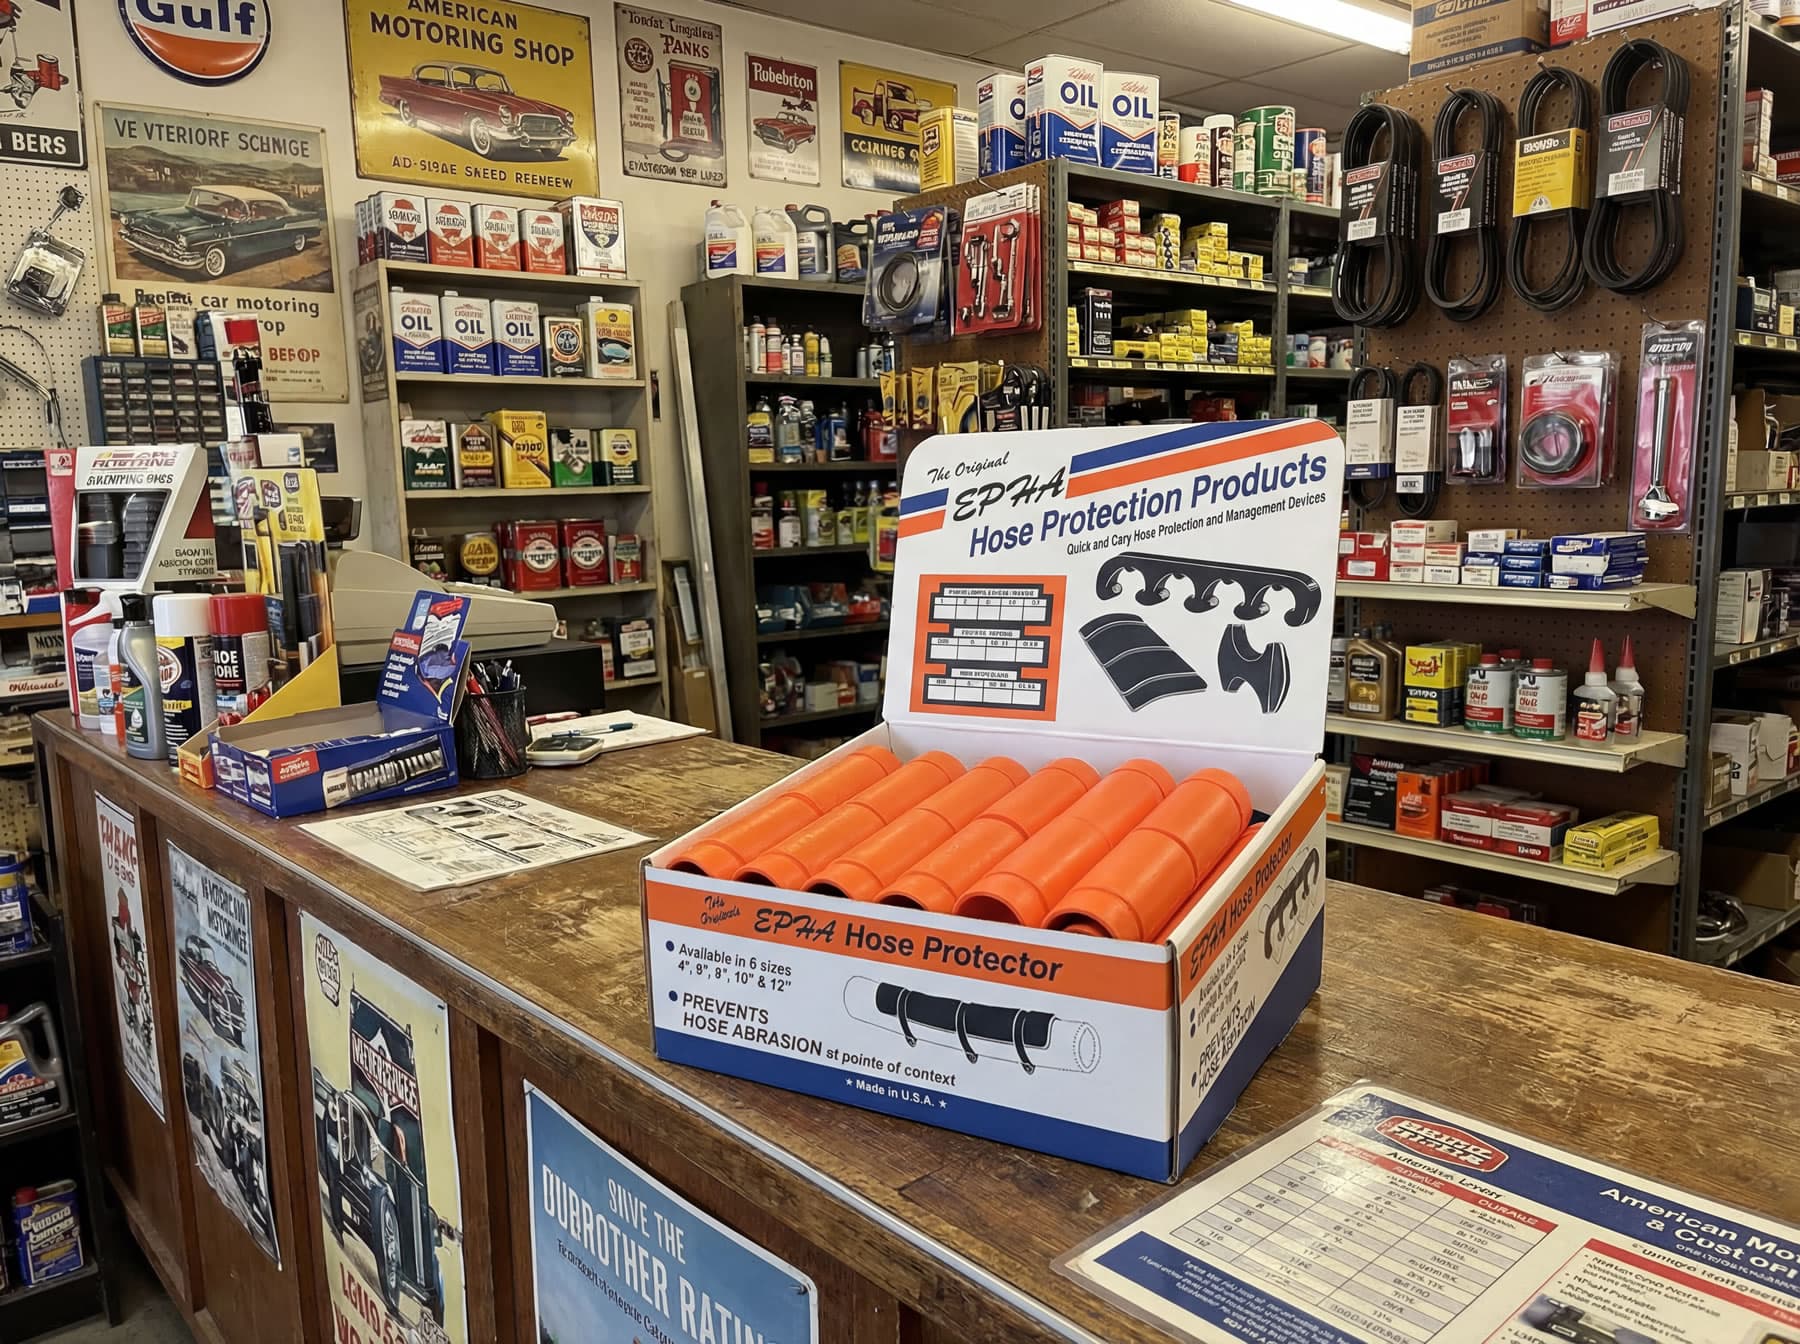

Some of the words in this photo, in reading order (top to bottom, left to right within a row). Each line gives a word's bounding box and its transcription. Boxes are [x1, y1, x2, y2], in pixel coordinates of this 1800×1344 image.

[136, 0, 256, 35] Gulf
[408, 0, 518, 30] AMERICAN
[370, 12, 504, 55] MOTORING
[514, 38, 575, 67] SHOP
[1060, 81, 1099, 108] OIL
[1112, 94, 1153, 119] OIL
[12, 132, 66, 155] BERS
[114, 117, 137, 139] VE
[201, 297, 229, 309] car
[236, 298, 319, 318] motoring
[401, 315, 433, 331] OIL
[455, 319, 485, 334] OIL
[505, 322, 534, 337] OIL
[927, 468, 951, 484] The
[955, 451, 1010, 477] Original
[953, 466, 1066, 522] EPHA
[969, 522, 1033, 558] Hose
[1041, 488, 1182, 542] Protection
[1191, 453, 1327, 508] Products
[1067, 541, 1091, 556] Quick
[1093, 537, 1110, 551] and
[1111, 533, 1132, 550] Cary
[1134, 527, 1156, 543] Hose
[1206, 514, 1224, 529] and
[1226, 498, 1286, 523] Management
[1288, 491, 1327, 510] Devices
[1229, 889, 1253, 926] Hose
[1254, 832, 1293, 889] Protector
[679, 944, 732, 965] Available
[736, 954, 746, 967] in
[749, 957, 757, 969] 6
[760, 960, 792, 976] sizes
[754, 908, 837, 943] EPHA
[845, 923, 914, 956] Hose
[922, 935, 1063, 982] Protector
[757, 975, 767, 989] &
[683, 993, 769, 1025] PREVENTS
[683, 1012, 728, 1036] HOSE
[732, 1023, 822, 1056] ABRASION
[826, 1048, 840, 1060] st
[841, 1053, 884, 1070] pointe
[887, 1061, 902, 1074] of
[904, 1066, 956, 1087] context
[856, 1080, 885, 1095] Made
[888, 1086, 898, 1099] in
[901, 1089, 934, 1107] U.S.A.
[1600, 1188, 1738, 1241] American
[654, 1211, 686, 1266] THE
[1646, 1218, 1665, 1232] &
[1674, 1228, 1746, 1262] Cost
